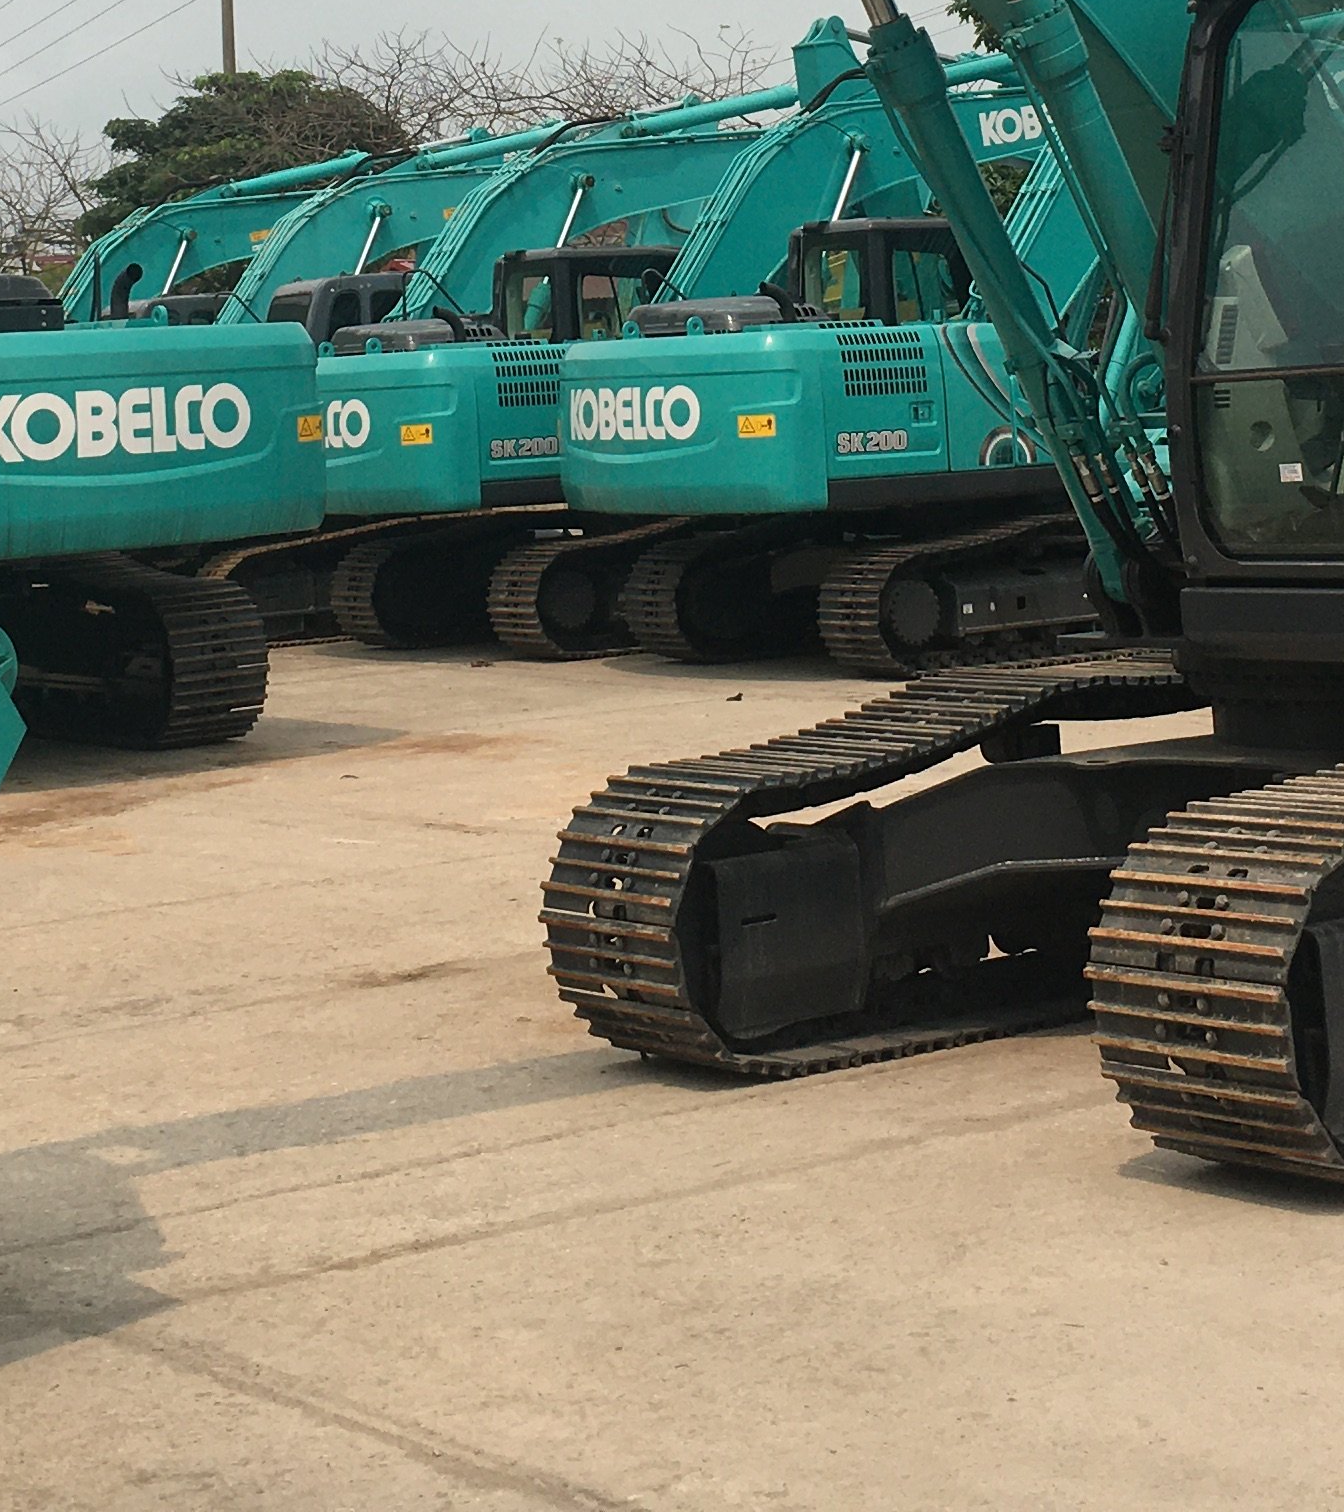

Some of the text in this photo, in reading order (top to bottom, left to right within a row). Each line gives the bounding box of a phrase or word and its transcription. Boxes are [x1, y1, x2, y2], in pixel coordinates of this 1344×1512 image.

[978, 104, 1053, 146] KOB
[325, 399, 370, 448] CO
[570, 384, 700, 440] KOBELCO
